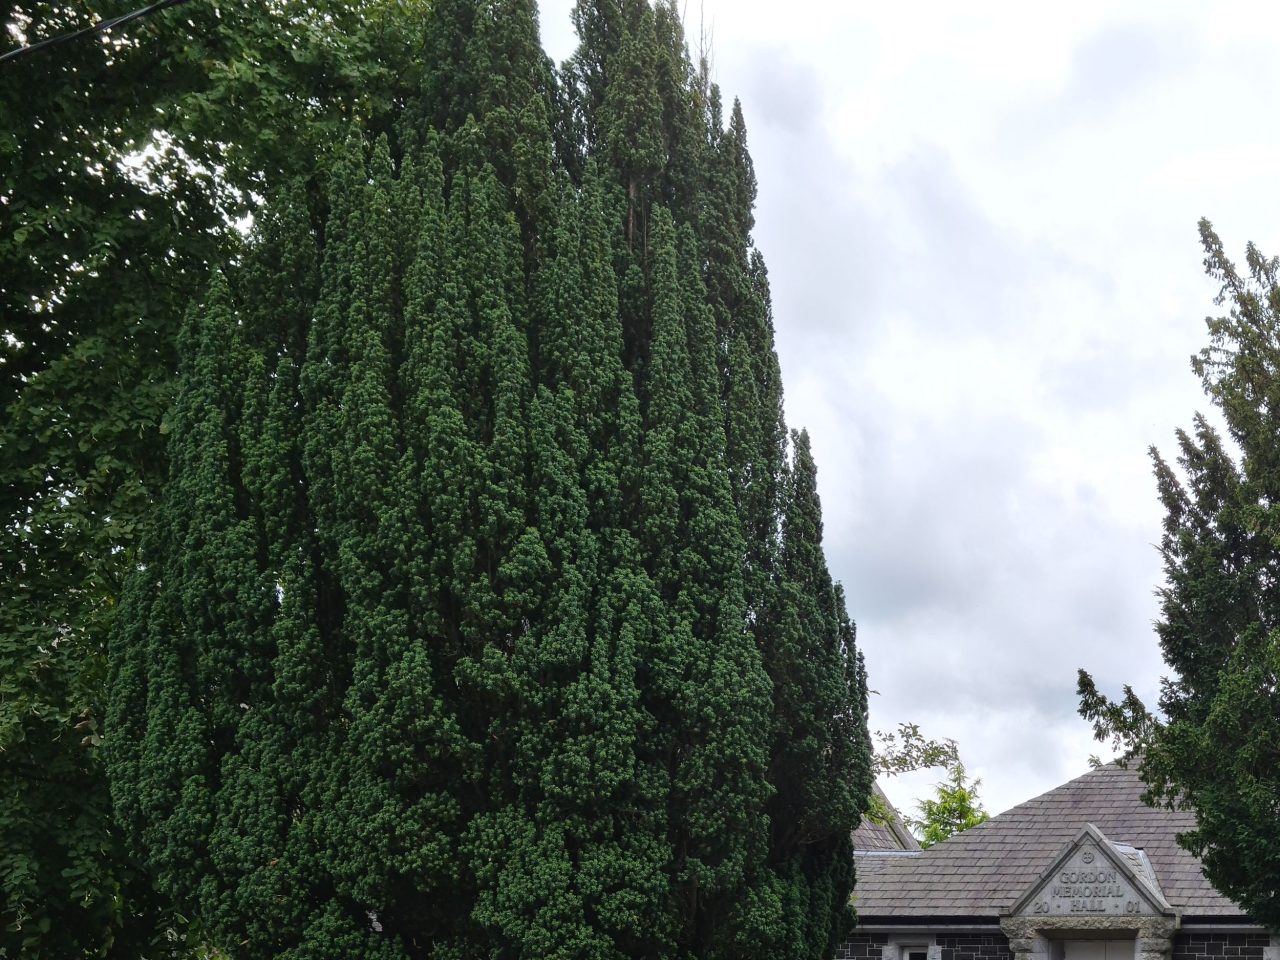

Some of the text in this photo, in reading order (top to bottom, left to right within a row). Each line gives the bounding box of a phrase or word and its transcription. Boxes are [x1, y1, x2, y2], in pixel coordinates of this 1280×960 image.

[1060, 872, 1116, 883] GORDON
[1052, 885, 1124, 898] MEMORIAL
[1034, 900, 1141, 914] 20 HALL 01
